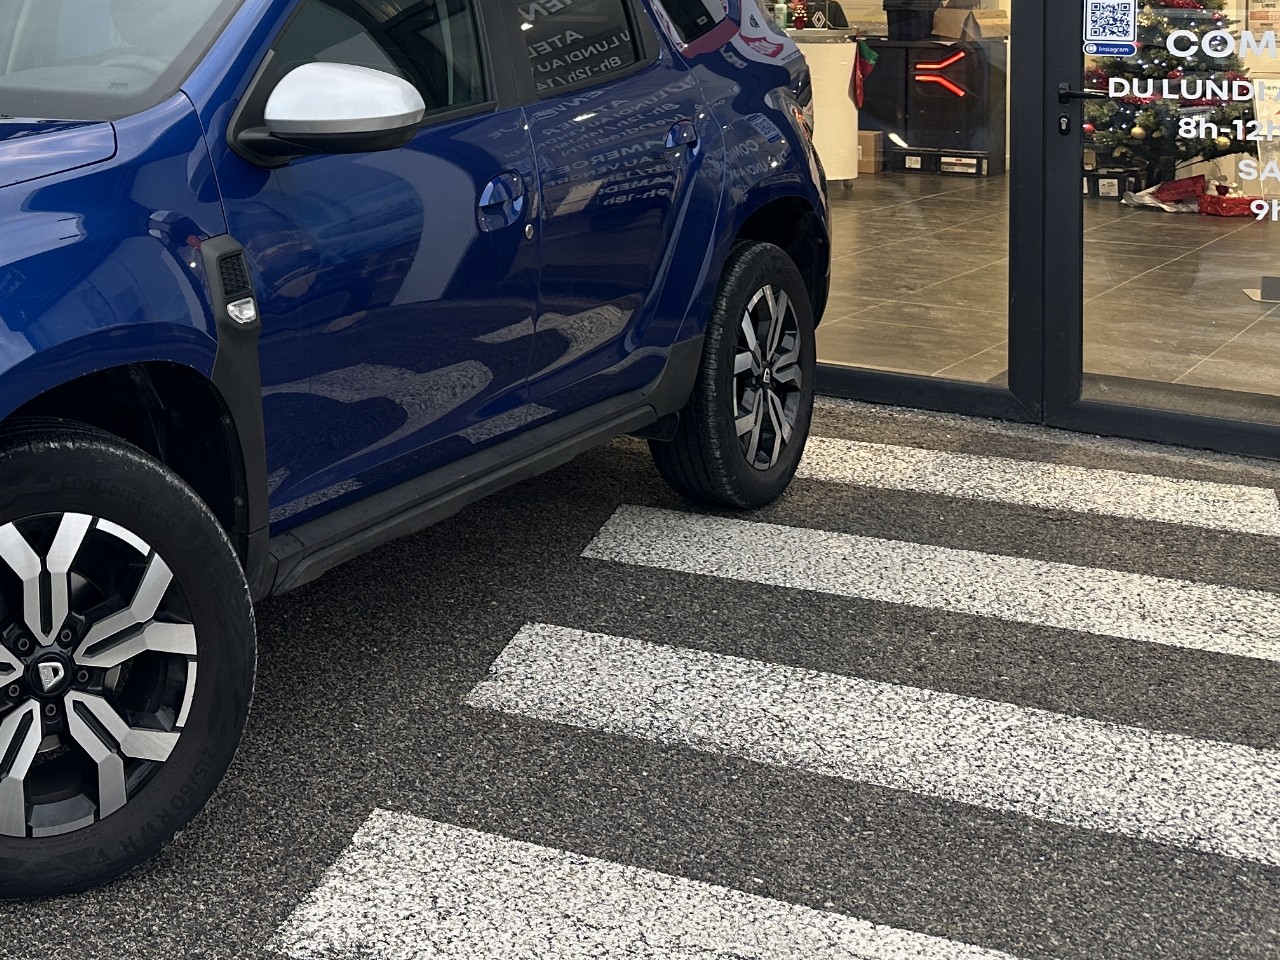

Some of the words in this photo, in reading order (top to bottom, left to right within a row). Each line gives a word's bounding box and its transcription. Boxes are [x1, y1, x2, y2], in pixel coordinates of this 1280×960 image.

[1166, 29, 1278, 58] COM
[1108, 77, 1154, 98] DU
[1162, 79, 1265, 101] LUNDI
